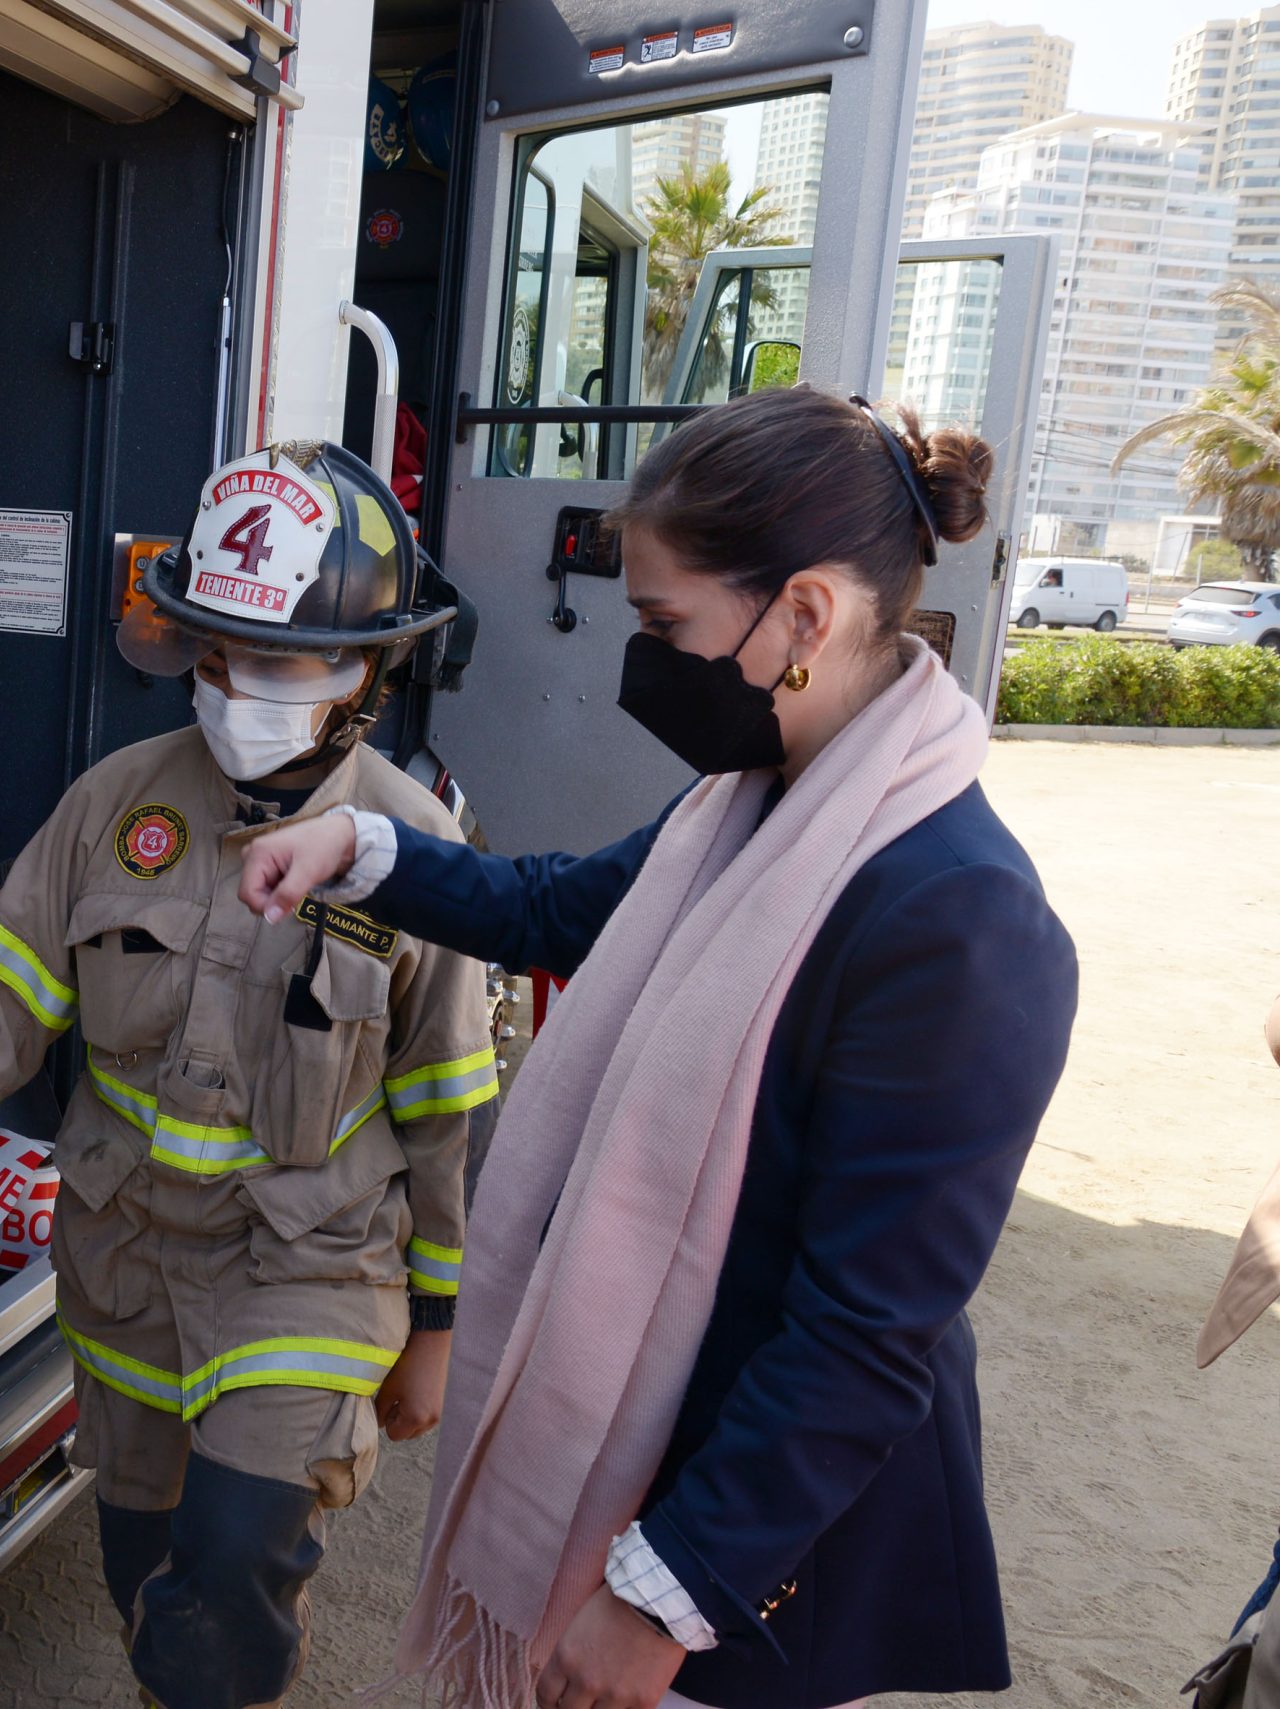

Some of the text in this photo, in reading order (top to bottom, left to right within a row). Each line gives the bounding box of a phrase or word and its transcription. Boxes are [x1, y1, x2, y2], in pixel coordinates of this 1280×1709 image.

[217, 474, 316, 522] VIÑA DEL MAR
[218, 503, 274, 576] 4
[199, 574, 261, 605] TENIENTE
[134, 807, 162, 818] RAFAEL
[147, 835, 157, 849] 4
[306, 904, 317, 916] C.
